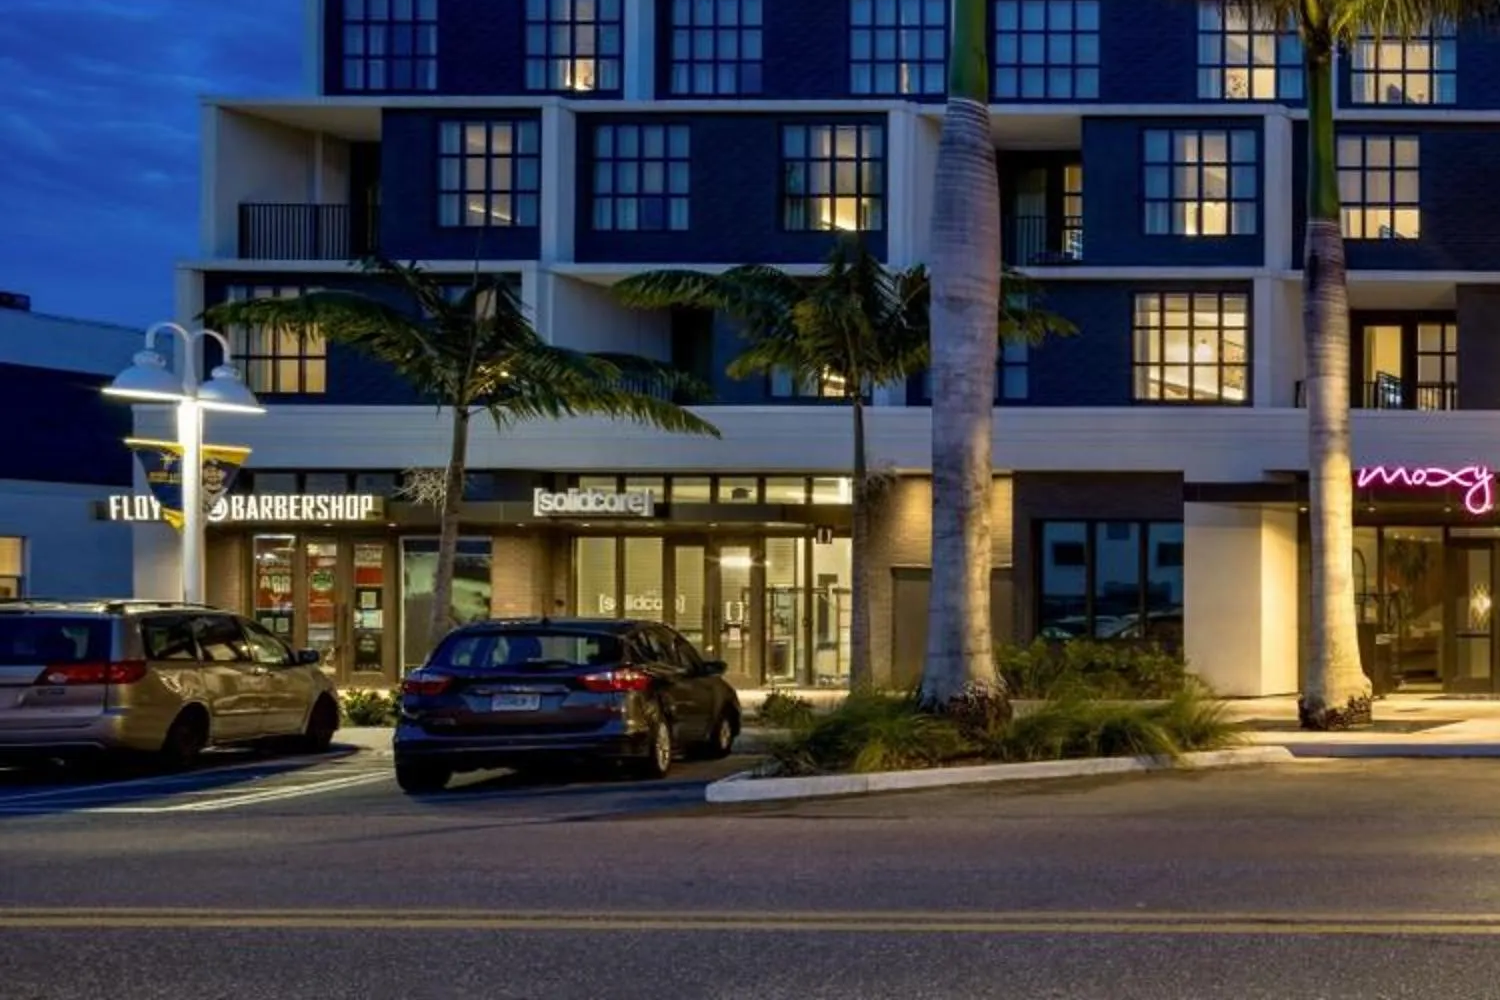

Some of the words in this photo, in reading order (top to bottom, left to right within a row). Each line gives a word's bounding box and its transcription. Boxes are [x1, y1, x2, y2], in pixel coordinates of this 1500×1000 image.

[109, 495, 161, 520] FLOY
[231, 494, 373, 520] BARBERSHOP
[1357, 466, 1494, 514] moxy
